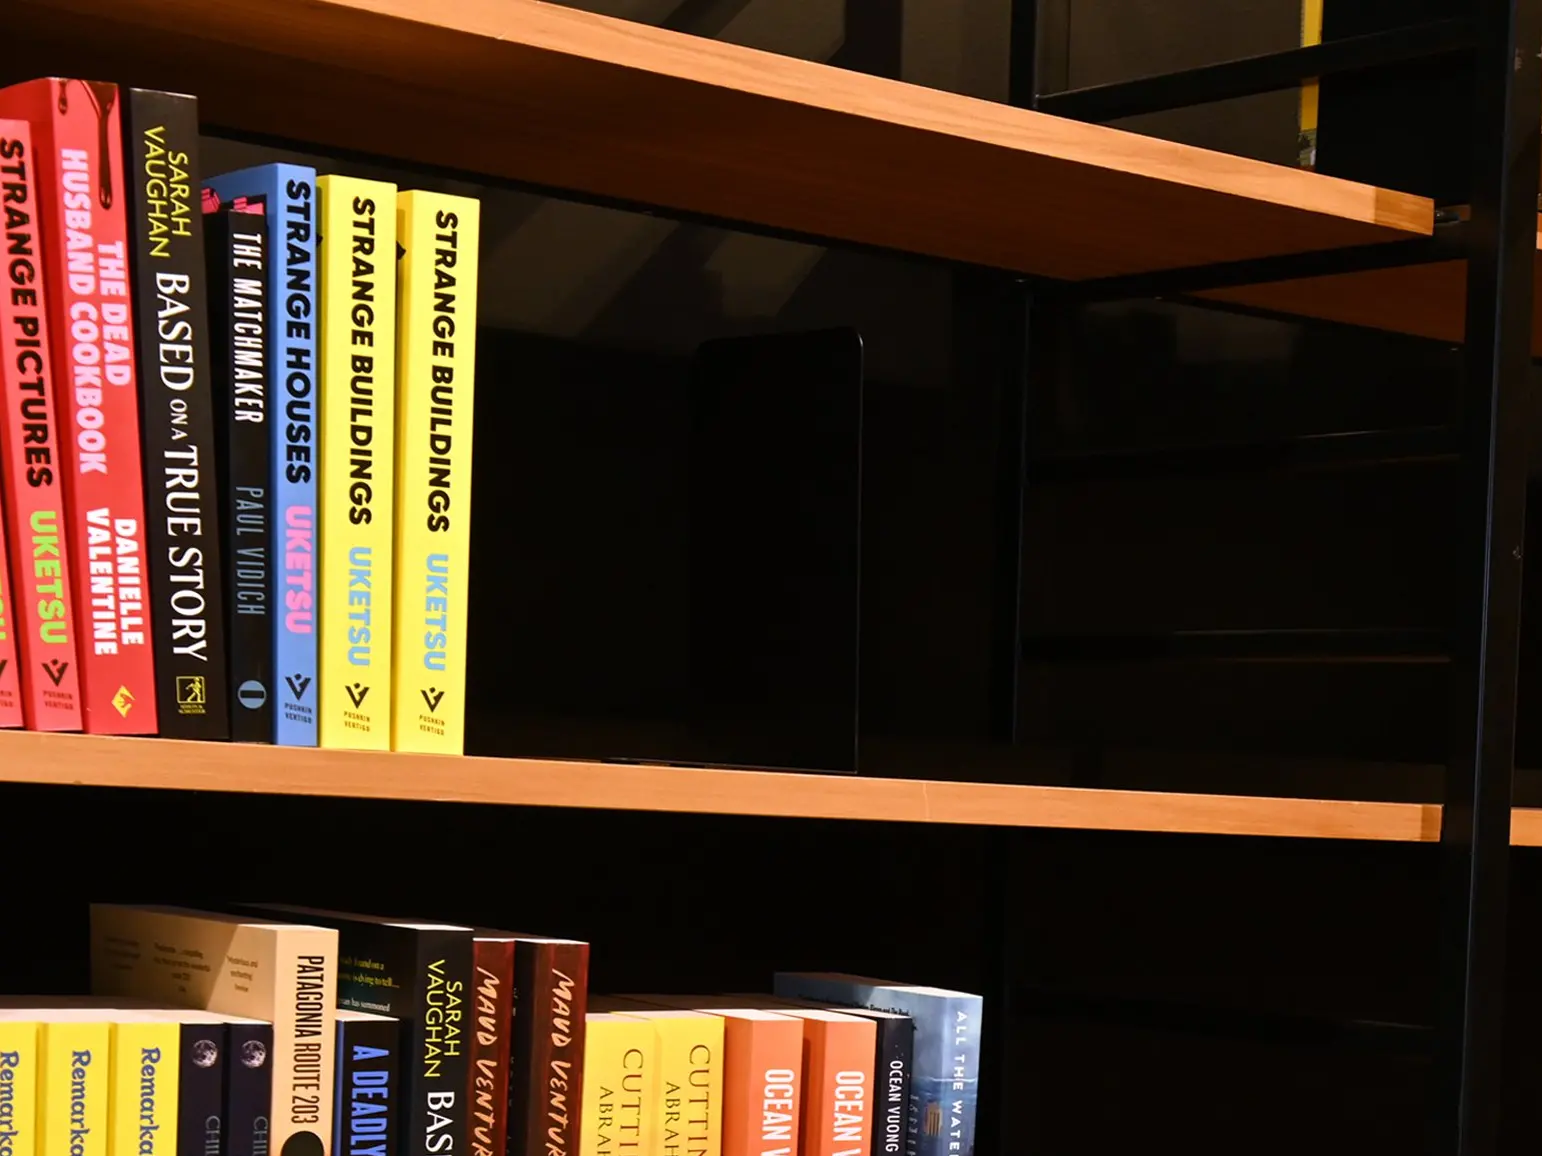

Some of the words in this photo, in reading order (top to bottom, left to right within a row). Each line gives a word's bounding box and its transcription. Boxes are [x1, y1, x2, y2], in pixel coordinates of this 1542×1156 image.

[0, 137, 37, 306] STRANGE
[61, 148, 95, 296] HUSBAND
[144, 126, 170, 258] VAUGHAN
[168, 151, 192, 237] SARAH
[98, 241, 125, 297] THE
[233, 232, 261, 268] THE
[286, 178, 311, 340] STRANGE
[350, 196, 375, 348] STRANGE
[100, 304, 131, 385] DEAD
[155, 272, 194, 391] BASED
[233, 278, 263, 424] MATCHMAKER
[13, 315, 53, 488] PICTURES
[71, 301, 107, 474] COOKBOOK
[171, 398, 189, 425] ON
[286, 349, 311, 484] HOUSES
[171, 426, 187, 440] A
[348, 353, 374, 525] BUILDINGS
[164, 444, 200, 536] TRUE
[236, 486, 263, 536] PAUL
[30, 510, 69, 644] UKETSU
[86, 508, 118, 656] VALENTINE
[114, 518, 145, 646] DANIELLE
[167, 546, 207, 662] STORY
[237, 547, 265, 616] VIDICH
[294, 955, 325, 1038] PATAGONIA
[476, 966, 500, 1046] MAUD
[954, 1010, 968, 1044] ALL
[293, 1042, 322, 1091] ROUTE
[353, 1045, 389, 1061] A
[952, 1055, 965, 1091] THE
[291, 1095, 320, 1124] 203
[763, 1068, 794, 1141] OCEAN
